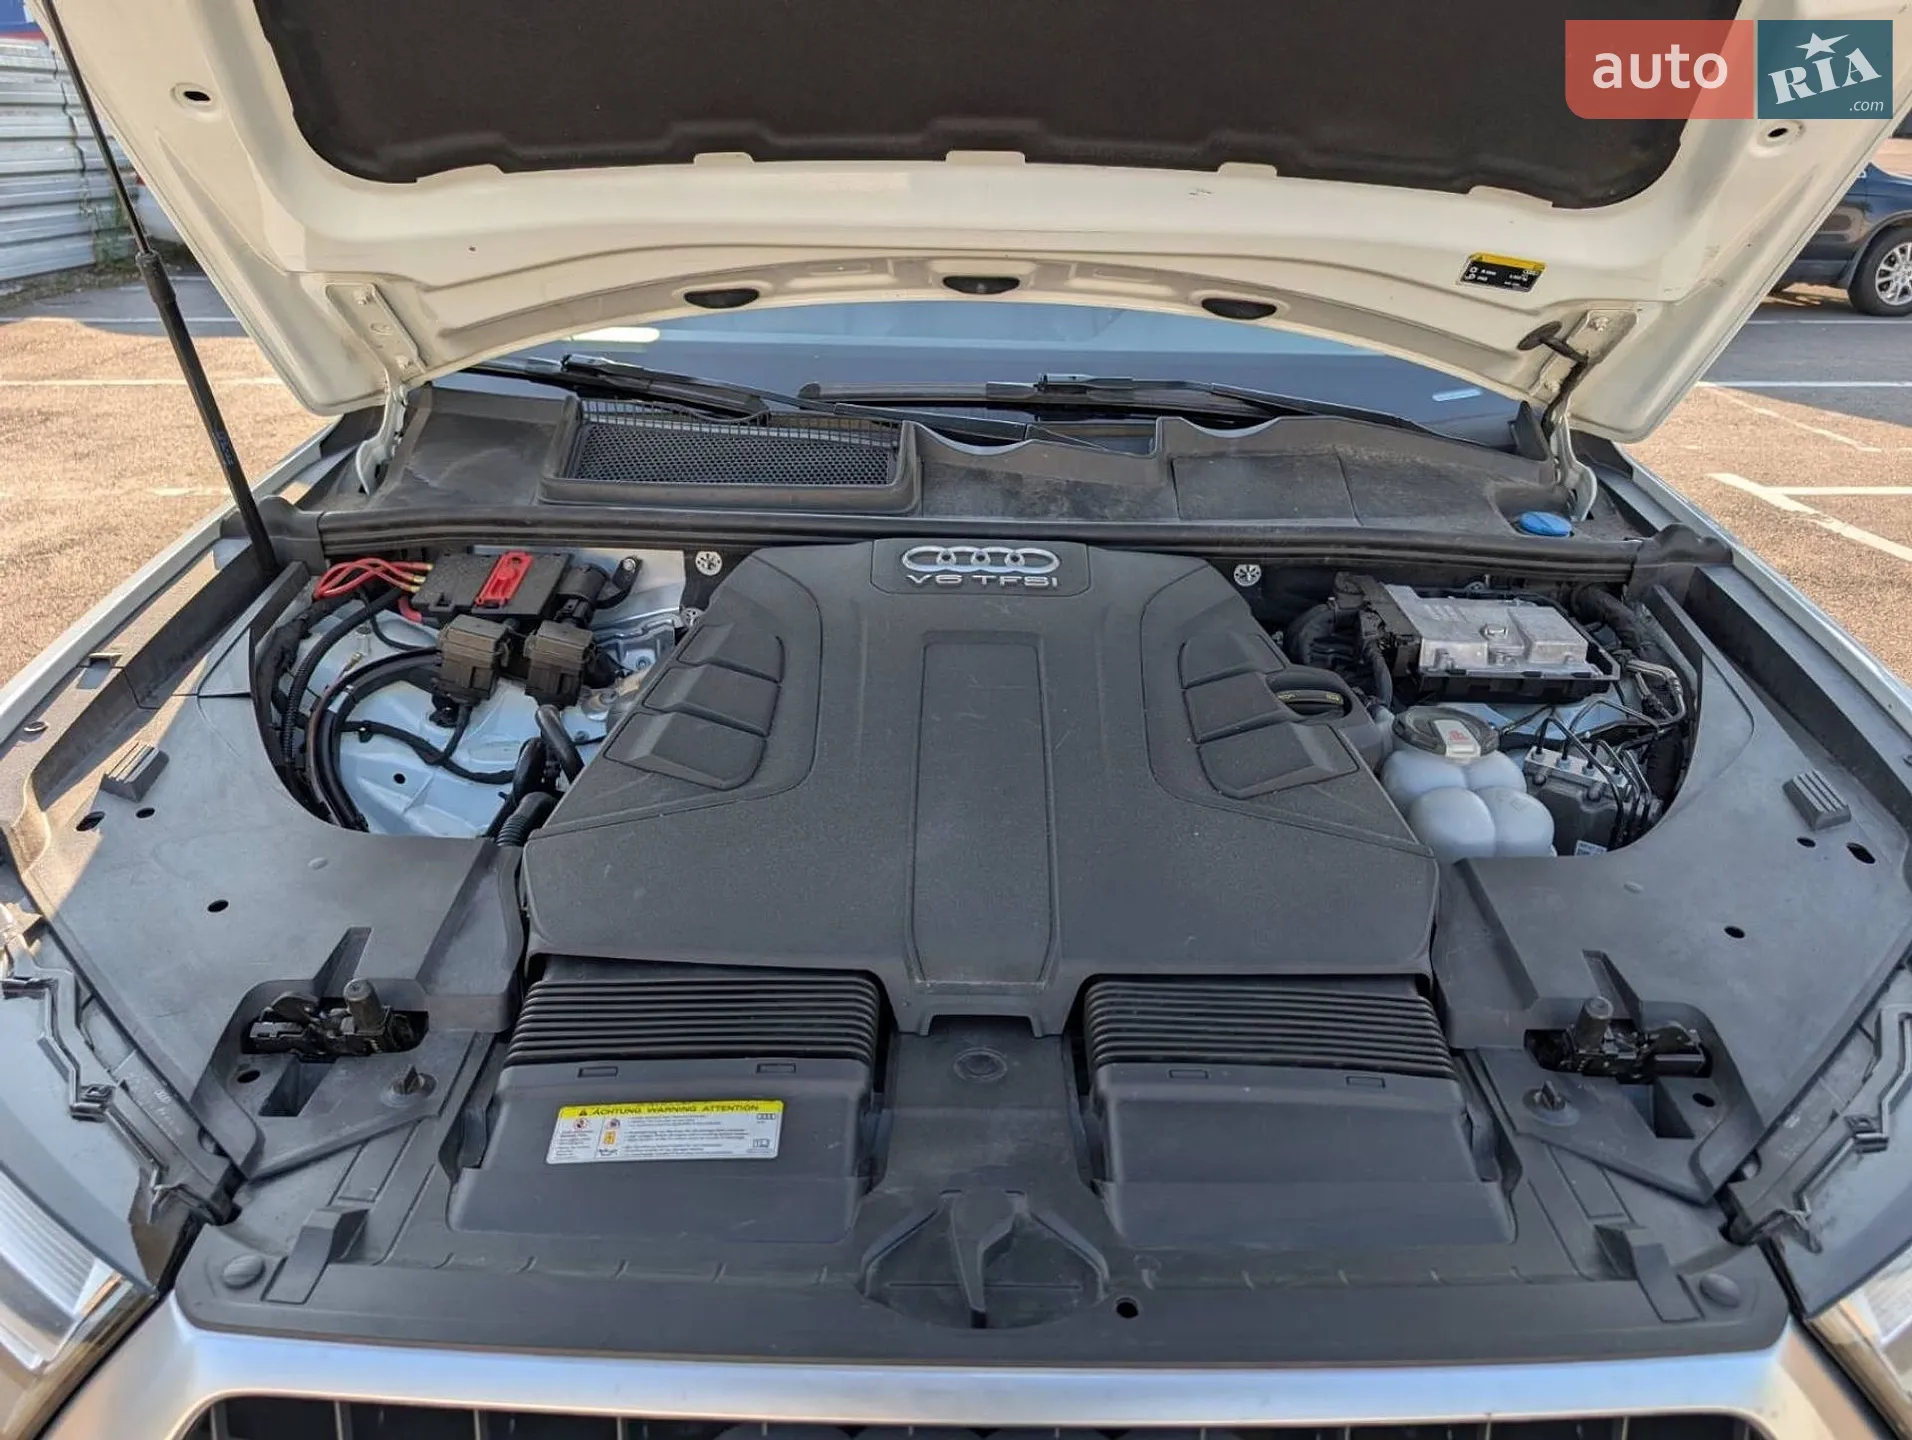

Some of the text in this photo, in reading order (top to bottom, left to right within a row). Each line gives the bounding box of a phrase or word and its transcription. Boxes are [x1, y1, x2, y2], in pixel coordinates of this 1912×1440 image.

[906, 574, 1058, 587] V6 TFSI
[592, 1104, 759, 1116] ACHTUNG WARNING ATTENTION
